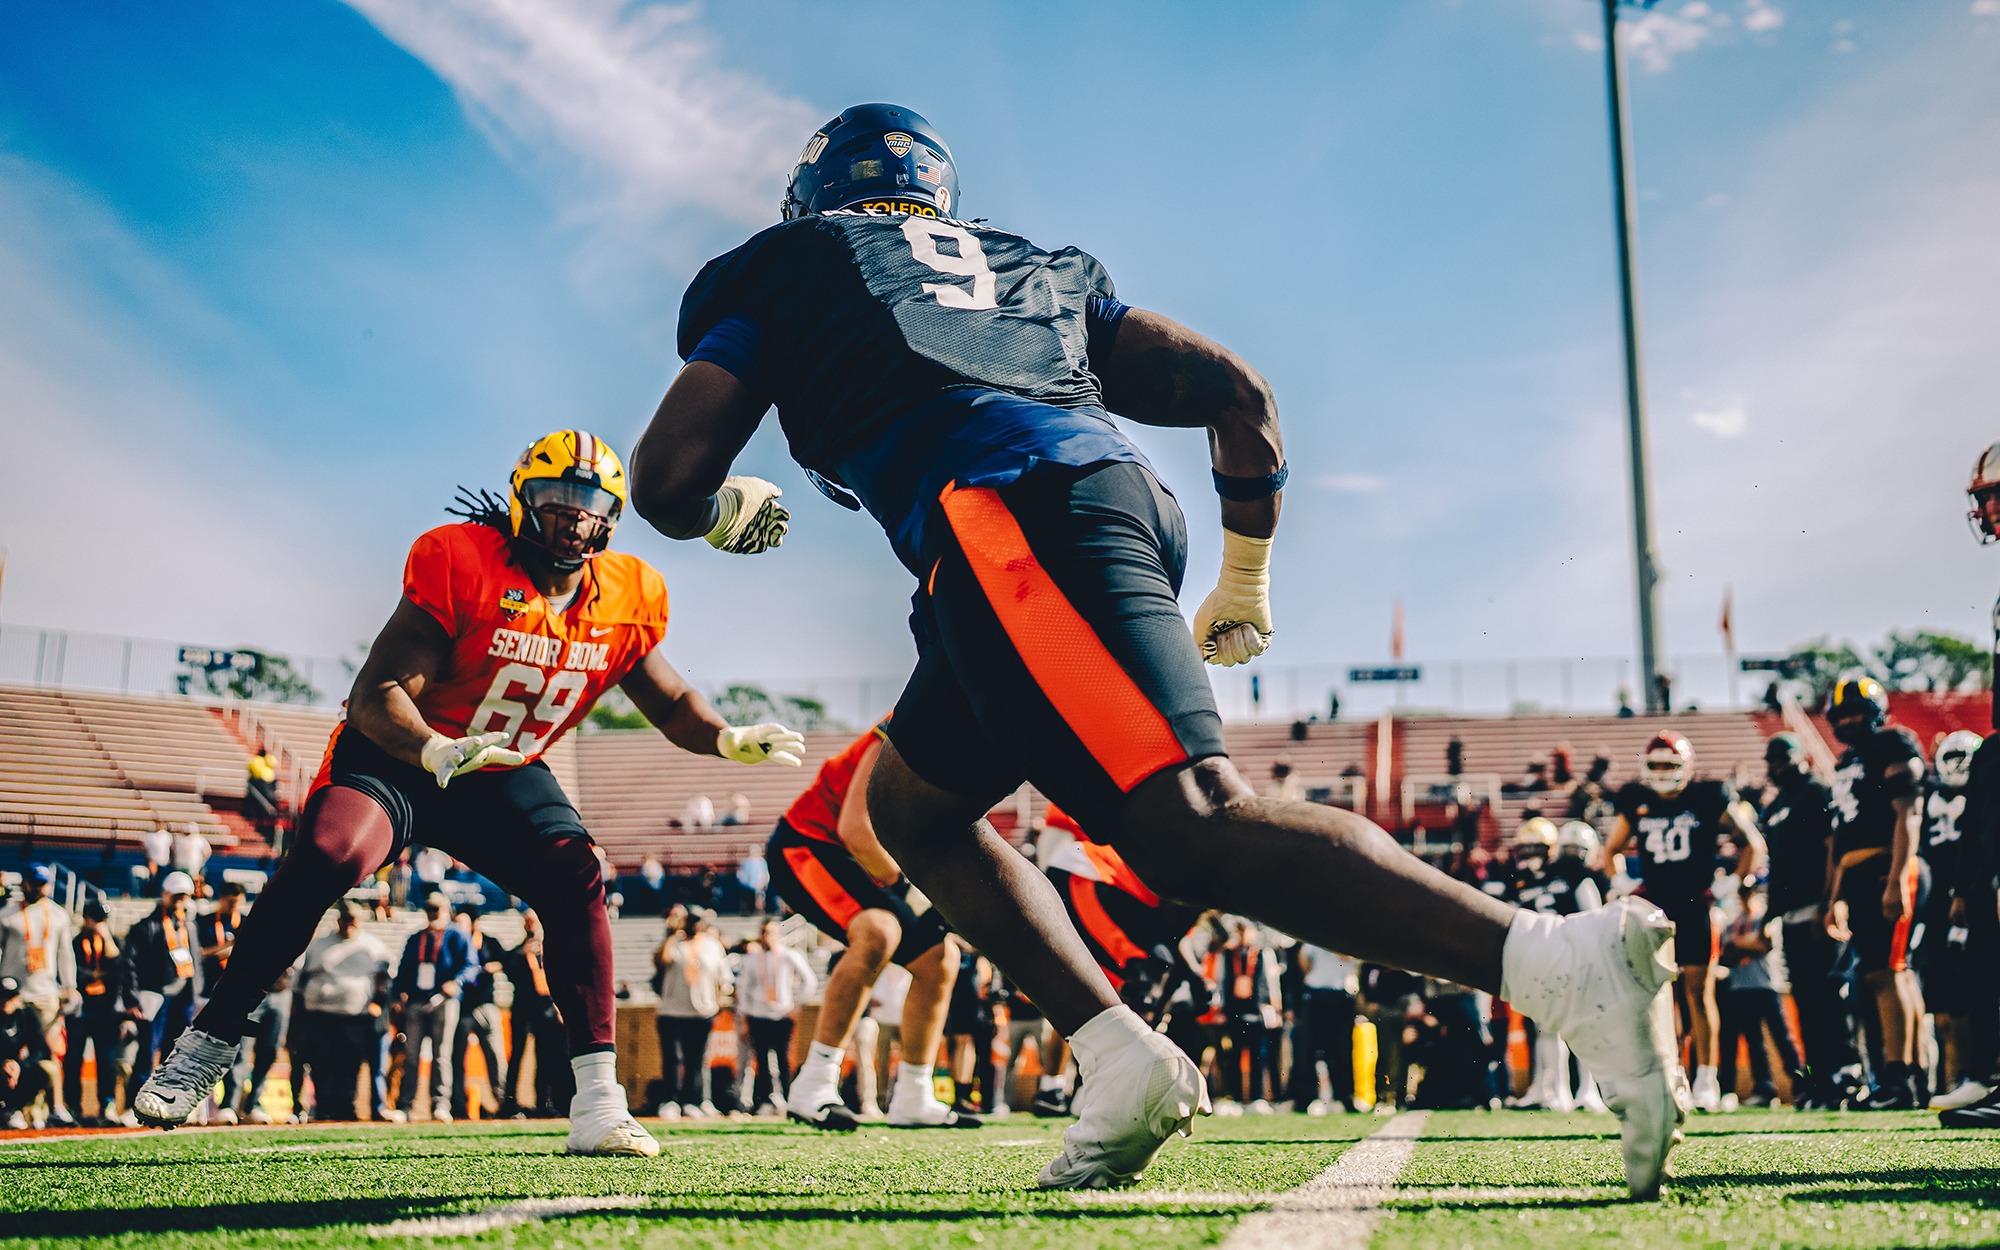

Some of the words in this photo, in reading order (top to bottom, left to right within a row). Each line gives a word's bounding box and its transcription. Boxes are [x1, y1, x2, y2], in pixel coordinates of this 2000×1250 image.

[899, 216, 1000, 310] 9
[488, 628, 562, 668] SENIOR
[564, 641, 610, 670] BOWL
[466, 661, 588, 757] 69
[1645, 827, 1690, 863] 40
